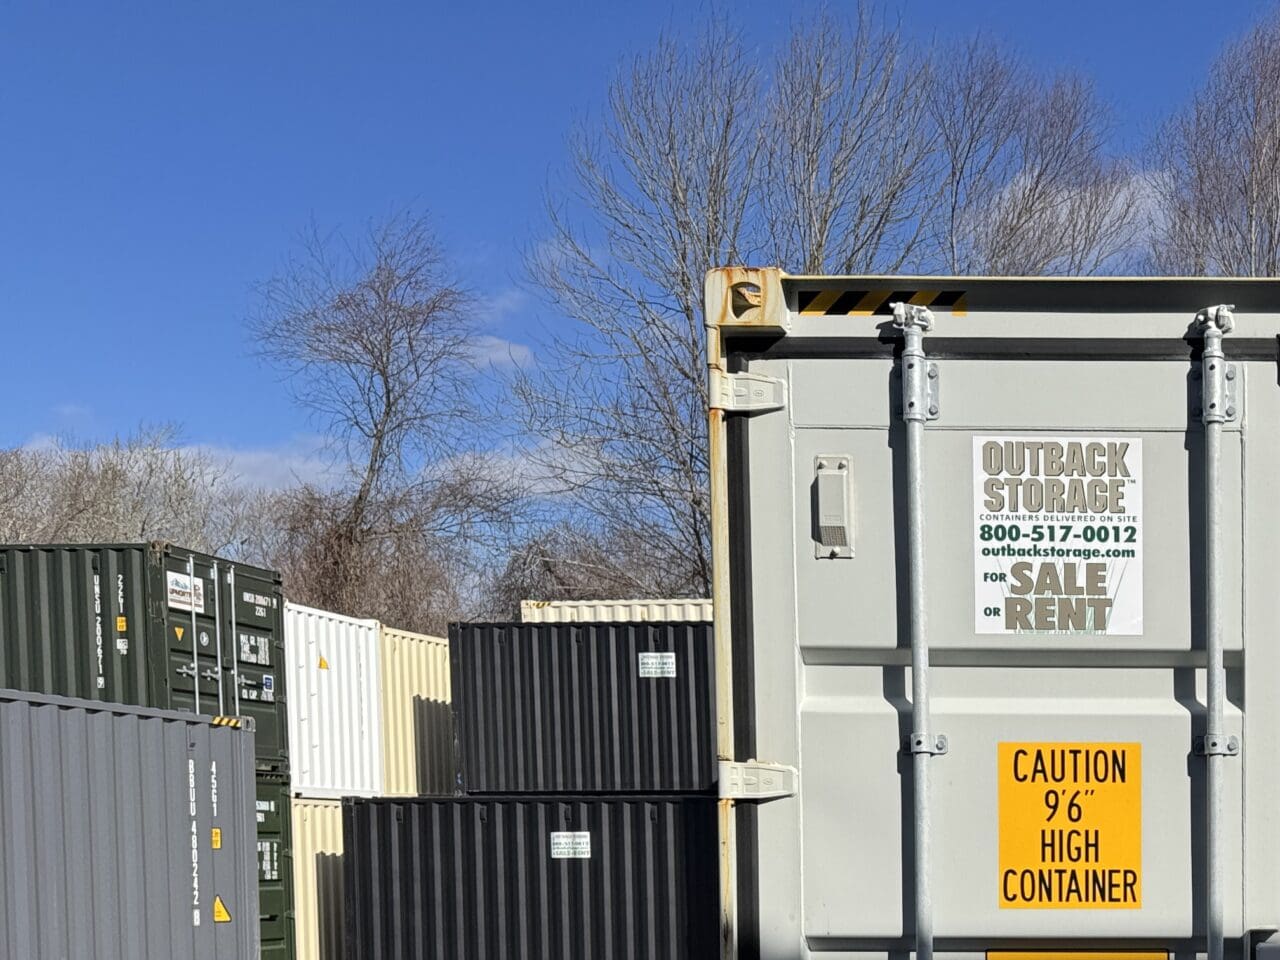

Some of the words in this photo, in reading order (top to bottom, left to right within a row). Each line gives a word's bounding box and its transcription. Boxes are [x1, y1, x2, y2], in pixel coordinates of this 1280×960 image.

[982, 440, 1131, 477] OUTBACK
[983, 477, 1126, 513] STORAGE
[979, 513, 1040, 522] CONTAINERS
[1043, 514, 1096, 522] DELIVERED
[1117, 515, 1138, 523] SITE
[979, 524, 1137, 543] 800-517-0012
[981, 544, 1136, 560] outbackstorage.com
[983, 572, 1007, 582] FOR
[1010, 561, 1107, 596] SALE
[983, 607, 1001, 617] OR
[1005, 596, 1113, 631] RENT
[1013, 749, 1126, 783] CAUTION
[191, 820, 199, 905] 480242
[1041, 829, 1100, 863] HIGH
[1003, 869, 1137, 903] CONTAINER
